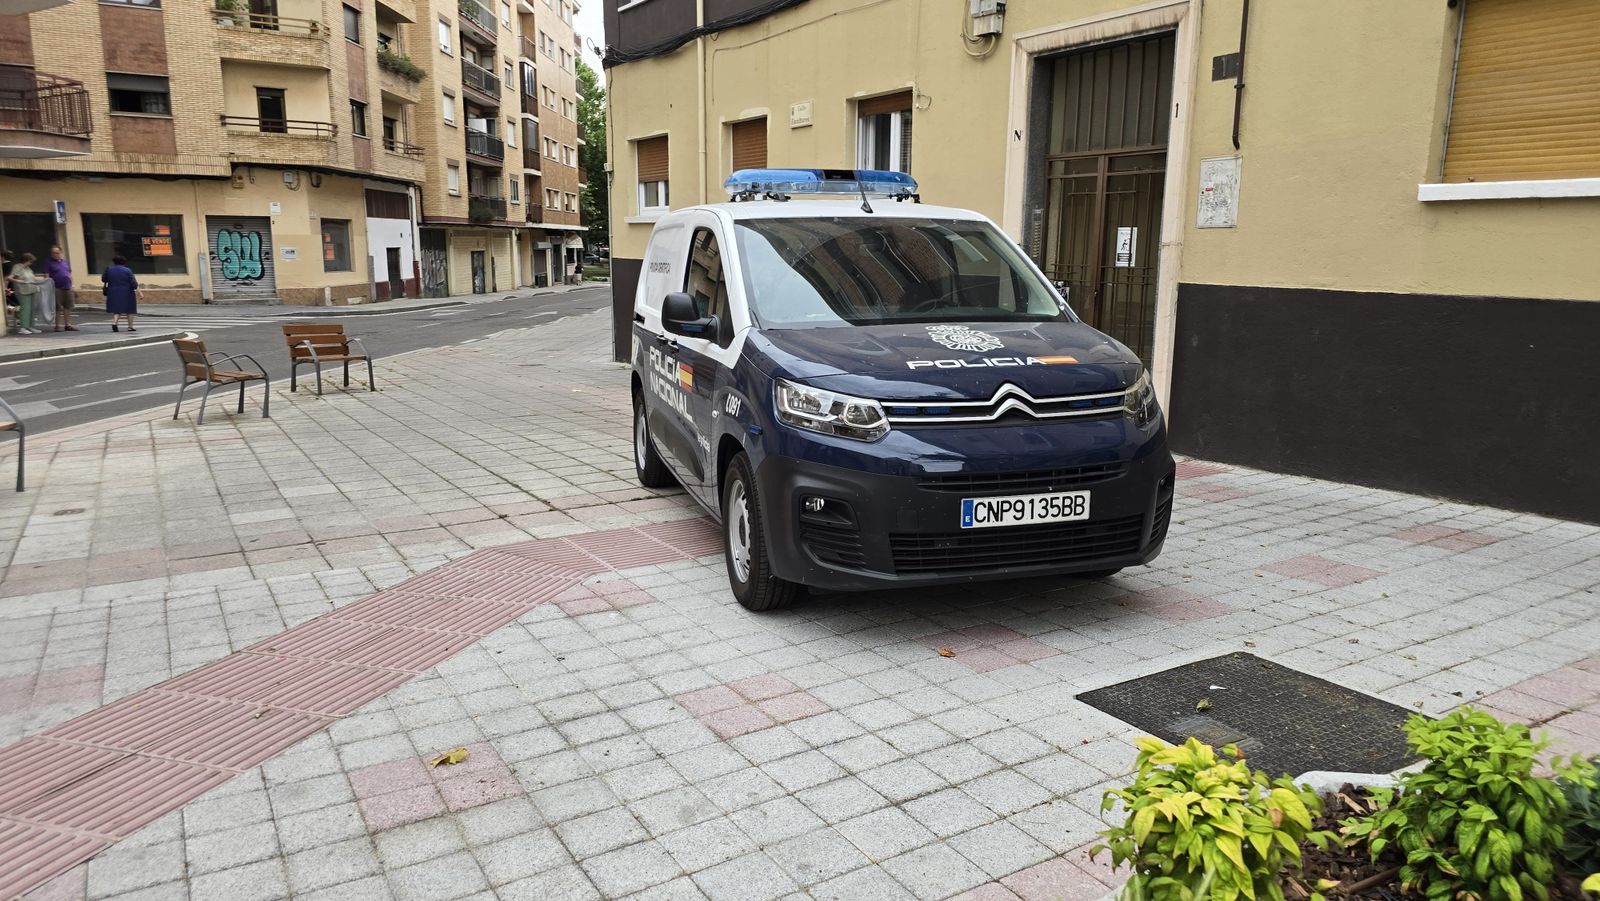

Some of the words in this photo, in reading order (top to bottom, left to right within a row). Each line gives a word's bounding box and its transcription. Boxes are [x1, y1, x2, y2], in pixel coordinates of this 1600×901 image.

[1013, 129, 1022, 142] N
[649, 345, 682, 387] POLICIA
[905, 357, 1047, 370] POLICIA
[649, 371, 693, 421] NACIONAL
[974, 494, 1086, 523] CNP9135BB
